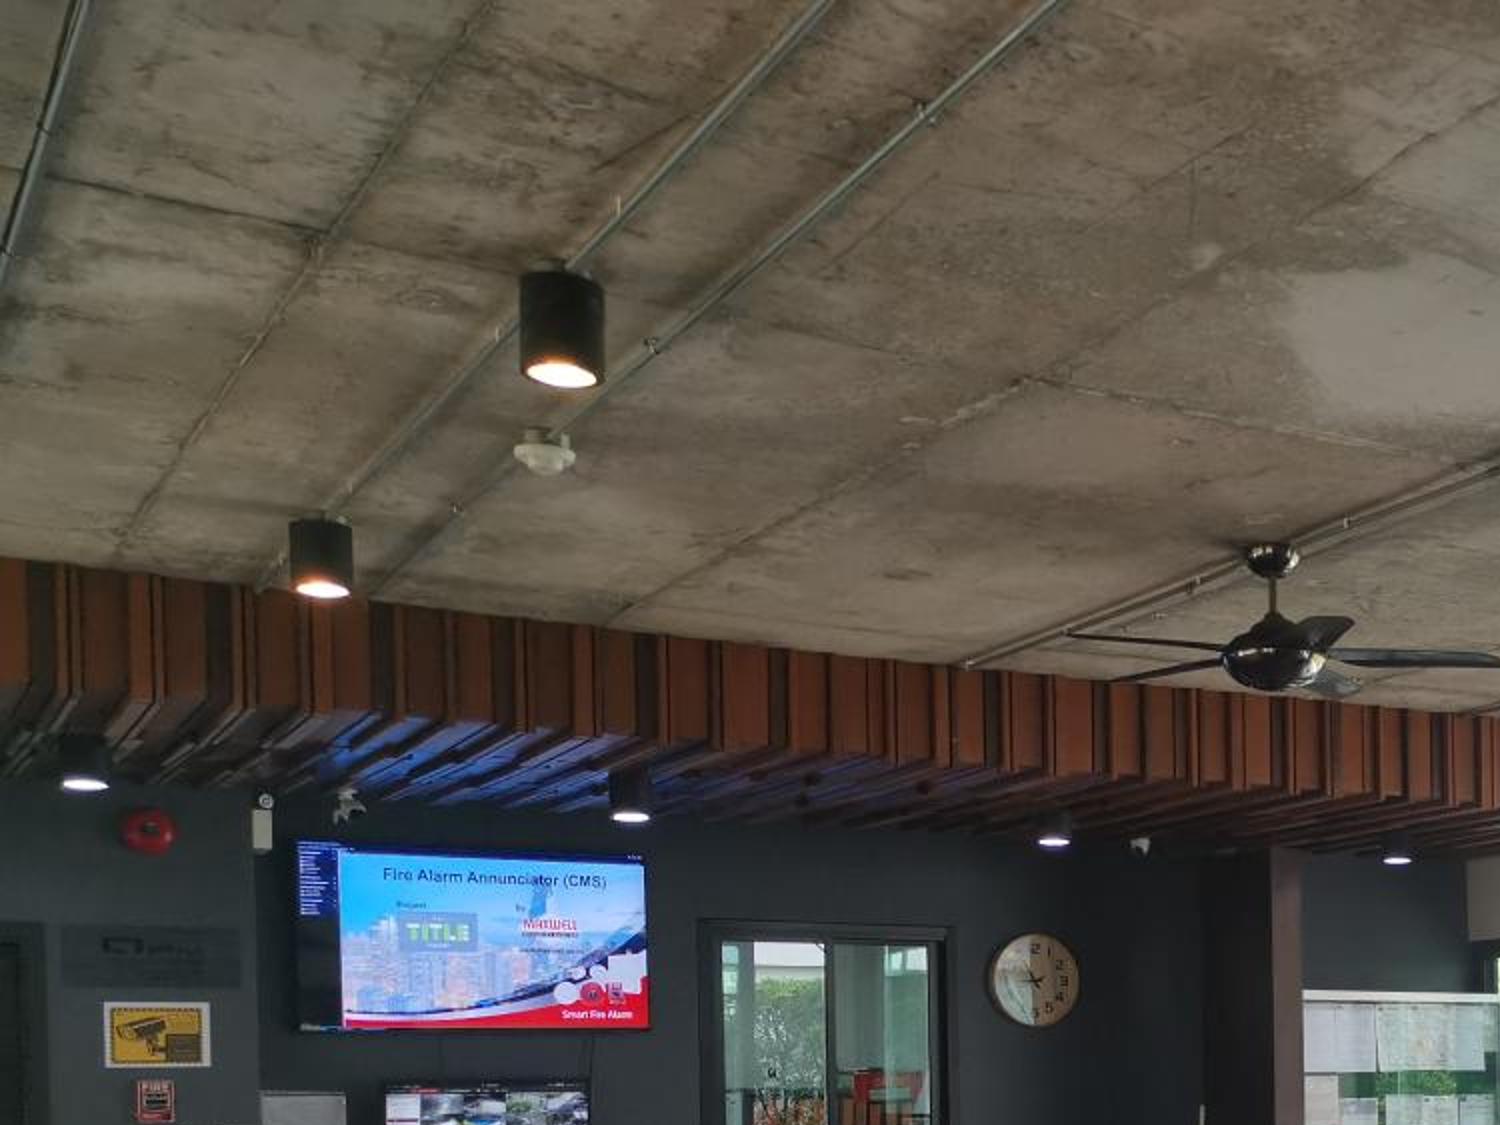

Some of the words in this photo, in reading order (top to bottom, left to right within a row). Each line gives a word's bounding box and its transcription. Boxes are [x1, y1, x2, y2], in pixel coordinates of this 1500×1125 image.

[383, 867, 413, 881] Fire
[417, 868, 463, 884] Alarm
[467, 871, 559, 887] Annunciator
[563, 874, 607, 890] (CMS)
[405, 922, 470, 942] TITLE
[561, 1009, 589, 1019] Smart
[607, 1009, 633, 1019] Alarm
